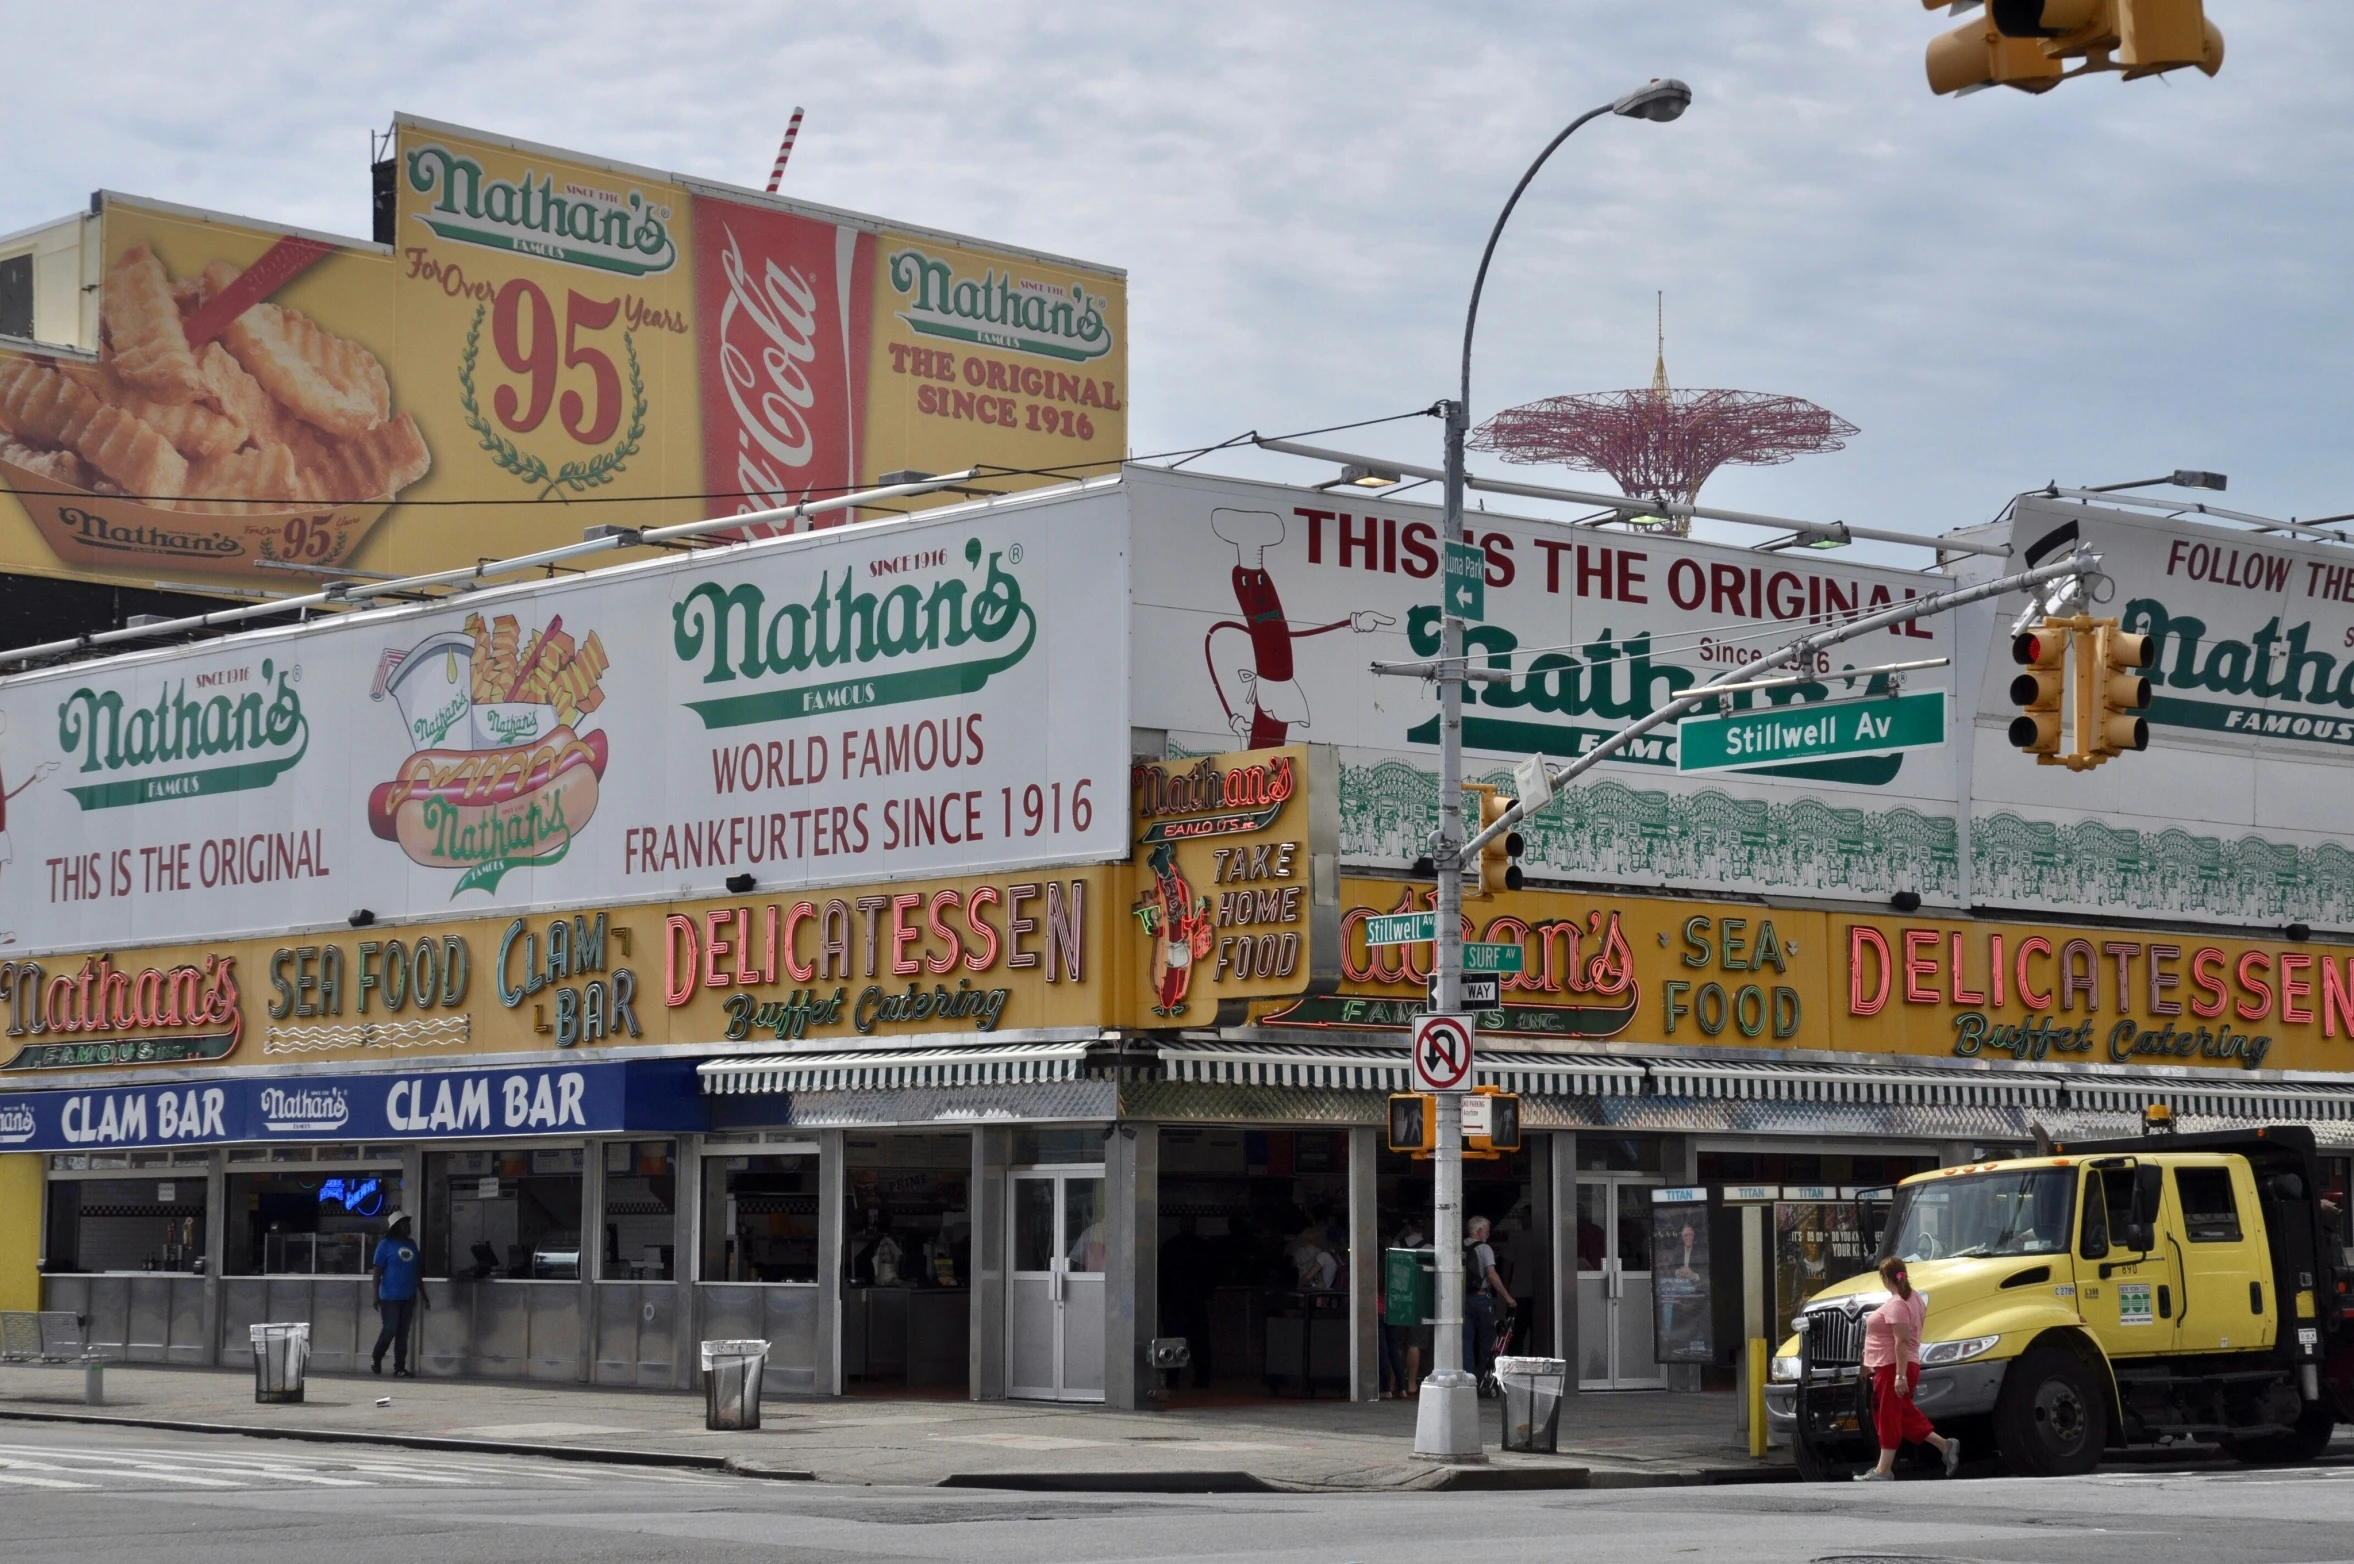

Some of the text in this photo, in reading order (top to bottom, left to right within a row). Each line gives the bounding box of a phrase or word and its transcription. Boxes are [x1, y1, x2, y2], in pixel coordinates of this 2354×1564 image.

[406, 147, 666, 255] Nathan's
[890, 252, 1104, 342] Nathan's
[405, 248, 689, 445] For Over 95 Years
[977, 331, 1020, 349] FAMOUS
[889, 342, 1121, 411] THE ORIGINAL
[918, 385, 1095, 441] SINCE 1916
[58, 506, 237, 552] Nathan's
[283, 513, 334, 560] 95
[869, 548, 948, 579] SINCE 1916
[1294, 507, 1439, 579] THIS
[1534, 538, 1648, 605] THE
[1667, 558, 1934, 640] ORIGINAL
[1446, 551, 1483, 580] Luna Park
[2167, 539, 2293, 593] FOLLOW
[672, 537, 1022, 684] Nathan's
[196, 667, 250, 688] SINCE 1916
[1699, 636, 1830, 674] Since 196
[58, 658, 301, 774] Nathan's
[414, 689, 467, 742] Nathan's
[487, 709, 537, 734] Nathan's
[802, 682, 875, 712] FAMOUS
[1726, 712, 1892, 755] Stillwell Av
[2225, 711, 2354, 740] FAMOUS
[712, 713, 984, 795] WORLD FAMOUS
[148, 776, 200, 798] FAMOUS
[1133, 755, 1296, 818] Nathan's
[422, 788, 566, 861] Nathan's
[625, 778, 1094, 875] FRANKFURTERS SINCE 1916
[46, 828, 330, 904] THIS IS THE ORIGINAL
[471, 860, 504, 880] FAMOUS
[1213, 841, 1302, 884] TAKE
[1216, 886, 1306, 928] HOME
[1368, 919, 1421, 943] Stillwell
[497, 912, 607, 1009] CLAM
[665, 879, 1087, 1008] DELICATESSEN
[1213, 932, 1300, 983] FOOD
[1468, 946, 1516, 969] SURF AV
[1680, 914, 1787, 974] SEA
[0, 952, 237, 1037] Nathan's
[267, 933, 469, 1020] SEA FOOD
[1468, 984, 1492, 1001] WAY
[1845, 923, 2354, 1038] DELICATESSEN
[555, 967, 643, 1048] BAR
[723, 978, 1012, 1041] Buffet Catering
[1663, 980, 1801, 1039] FOOD
[43, 1042, 155, 1065] FAMOUS
[1953, 1012, 2273, 1070] Buffet Catering
[61, 1088, 226, 1143] CLAM BAR
[261, 1087, 346, 1118] Nathan's
[386, 1072, 587, 1132] CLAM BAR
[1665, 1189, 1693, 1200] TITAN
[1739, 1187, 1765, 1198] TITAN
[1799, 1187, 1824, 1198] TITAN
[1832, 1243, 1851, 1257] YOUR
[1840, 1231, 1851, 1242] YOU
[2120, 1293, 2150, 1314] DOT
